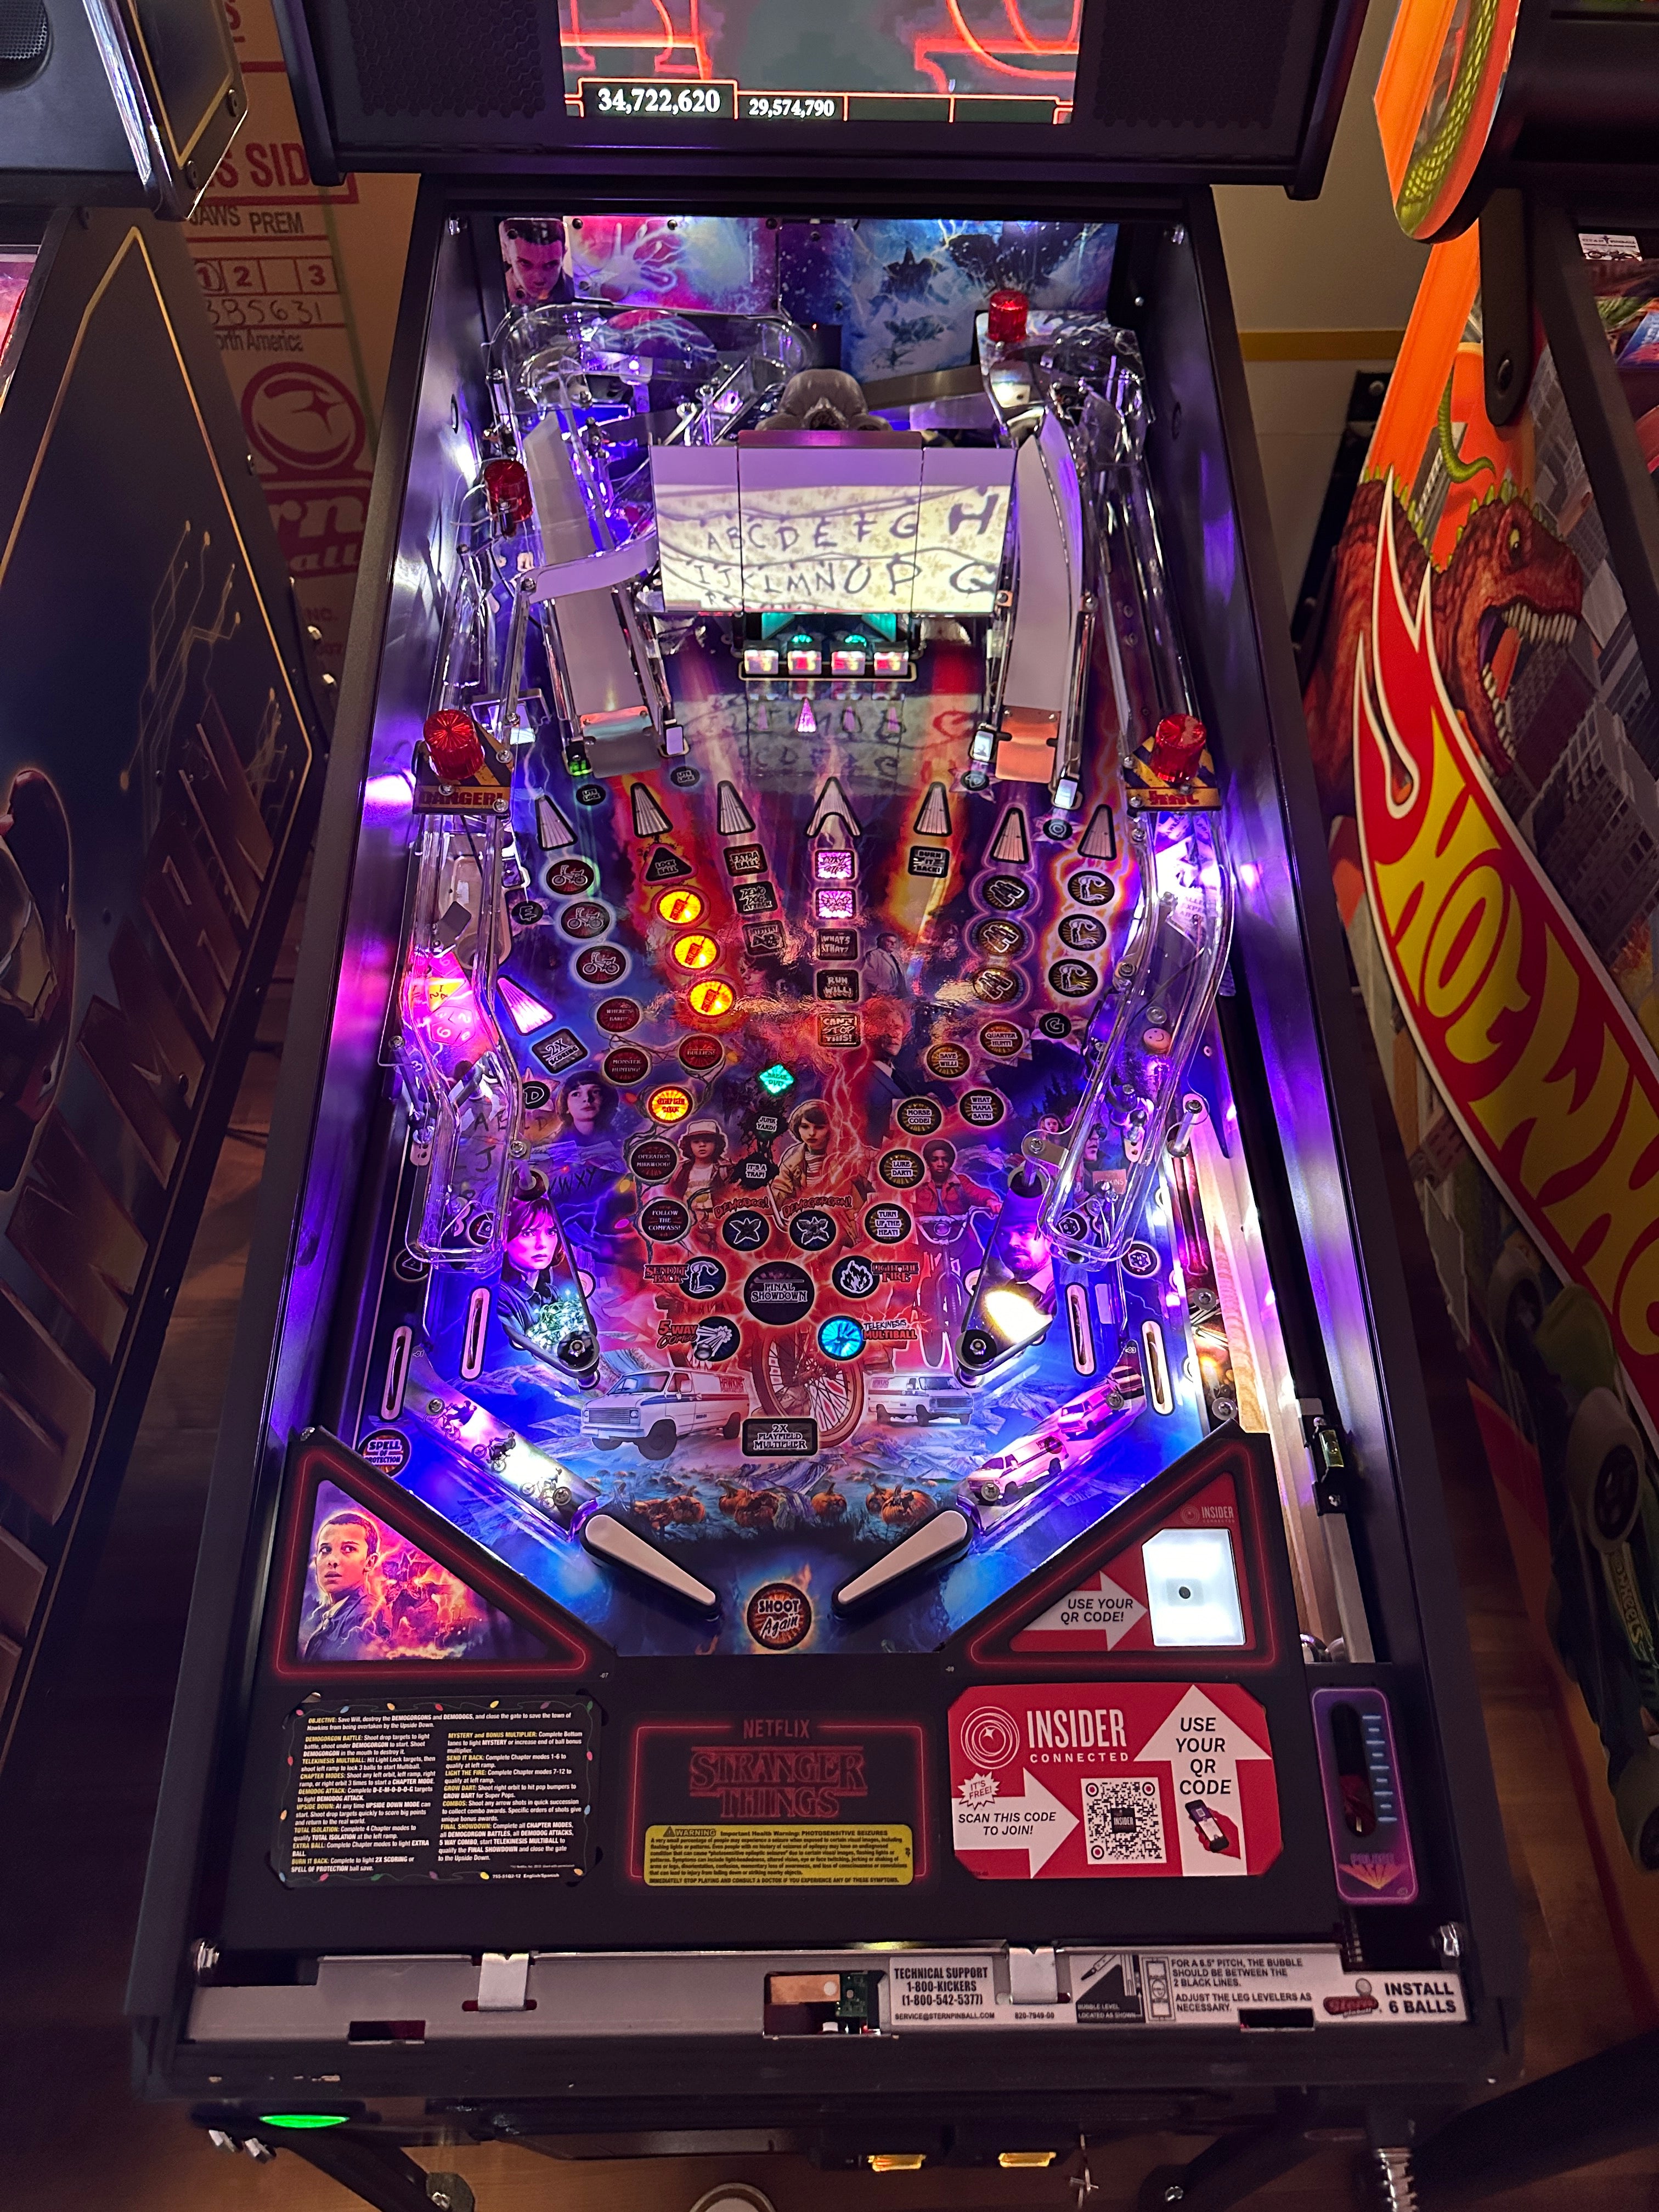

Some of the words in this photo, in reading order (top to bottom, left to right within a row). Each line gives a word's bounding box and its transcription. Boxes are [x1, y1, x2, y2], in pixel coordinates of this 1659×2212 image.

[598, 89, 721, 114] 34,722,620
[748, 99, 834, 117] 29,574,790
[245, 143, 311, 188] SID
[249, 211, 304, 234] PREM
[233, 266, 252, 287] 2
[308, 264, 325, 286] 3
[247, 331, 303, 352] America
[731, 851, 759, 862] EXTRA
[918, 850, 942, 859] BURN
[656, 860, 676, 869] LOCK
[736, 859, 759, 870] BALL
[916, 865, 941, 873] BACK!
[658, 866, 679, 876] BALL
[822, 935, 850, 945] WHAT'S
[827, 976, 848, 985] RUN
[823, 986, 852, 997] WILL!
[822, 1025, 855, 1034] STOP
[1045, 1017, 1065, 1034] G
[825, 1034, 852, 1042] THIS!
[545, 1037, 568, 1057] 2X
[548, 1045, 579, 1065] SCORING
[524, 1086, 545, 1104] D
[714, 1197, 769, 1219] DEMODOG!
[782, 1195, 853, 1218] DEMOGORGON!
[645, 1266, 674, 1276] SEND
[653, 1275, 683, 1283] BACK
[882, 1272, 911, 1283] FIRE
[764, 1283, 795, 1292] FINAL
[751, 1290, 808, 1303] SHOWDOWN
[658, 1320, 698, 1335] 5-WAY
[864, 1319, 906, 1330] TELEKINESIS
[862, 1329, 918, 1340] MULTIBALL
[772, 1424, 788, 1433] 2X
[369, 1441, 401, 1451] SPELL
[753, 1440, 807, 1450] MULTIPLIER
[1201, 1506, 1234, 1519] INSIDER
[758, 1599, 800, 1613] SHOOT
[1068, 1599, 1094, 1609] USE
[1098, 1599, 1133, 1609] YOUR
[1060, 1612, 1079, 1625] QR
[1084, 1612, 1124, 1622] CODE!
[761, 1614, 799, 1638] Again
[743, 1719, 810, 1739] NETFLIX
[1027, 1709, 1127, 1749] INSIDER
[1180, 1717, 1217, 1732] USE
[1176, 1737, 1226, 1753] YOUR
[1030, 1753, 1129, 1763] CONNECTED
[690, 1750, 867, 1790] STRANGER
[1190, 1758, 1216, 1778] QR
[970, 1780, 986, 1791] IT'S
[1180, 1779, 1232, 1795] CODE
[968, 1786, 994, 1799] FREE!
[719, 1787, 840, 1818] THINGS
[958, 1813, 990, 1824] SCAN
[993, 1813, 1020, 1823] THIS
[1022, 1812, 1057, 1822] CODE
[1113, 1817, 1134, 1827] INSIDER
[675, 1829, 716, 1837] WARNING
[983, 1826, 999, 1836] TO
[1002, 1825, 1034, 1836] JOIN!
[1171, 1959, 1189, 1967] FOR
[1191, 1959, 1198, 1967] A
[1216, 1959, 1245, 1968] PITCH,
[1247, 1959, 1265, 1967] THE
[1266, 1958, 1304, 1967] BUBBLE
[894, 1967, 944, 1979] TECHNICAL
[946, 1967, 988, 1979] SUPPORT
[1172, 1968, 1209, 1977] SHOULD
[1225, 1968, 1268, 1977] BETWEEN
[1270, 1968, 1288, 1977] THE
[906, 1980, 977, 1992] 1-800-KICKERS
[1173, 1978, 1180, 1987] 2
[1181, 1979, 1211, 1987] BLACK
[1214, 1978, 1242, 1987] LINES.
[1384, 1982, 1455, 1996] INSTALL
[902, 1994, 983, 2006] (1-800-542-5377)
[1175, 1993, 1210, 2002] ADJUST
[1212, 1993, 1230, 2001] THE
[1232, 1993, 1250, 2001] LEG
[1252, 1993, 1297, 2001] LEVELERS
[1299, 1992, 1312, 2001] AS
[1176, 2003, 1233, 2012] NECESSARY.
[1389, 2000, 1400, 2014] 6
[1403, 2000, 1457, 2014] BALLS
[895, 2012, 995, 2021] SERVICE@STERNPINBALL.COM
